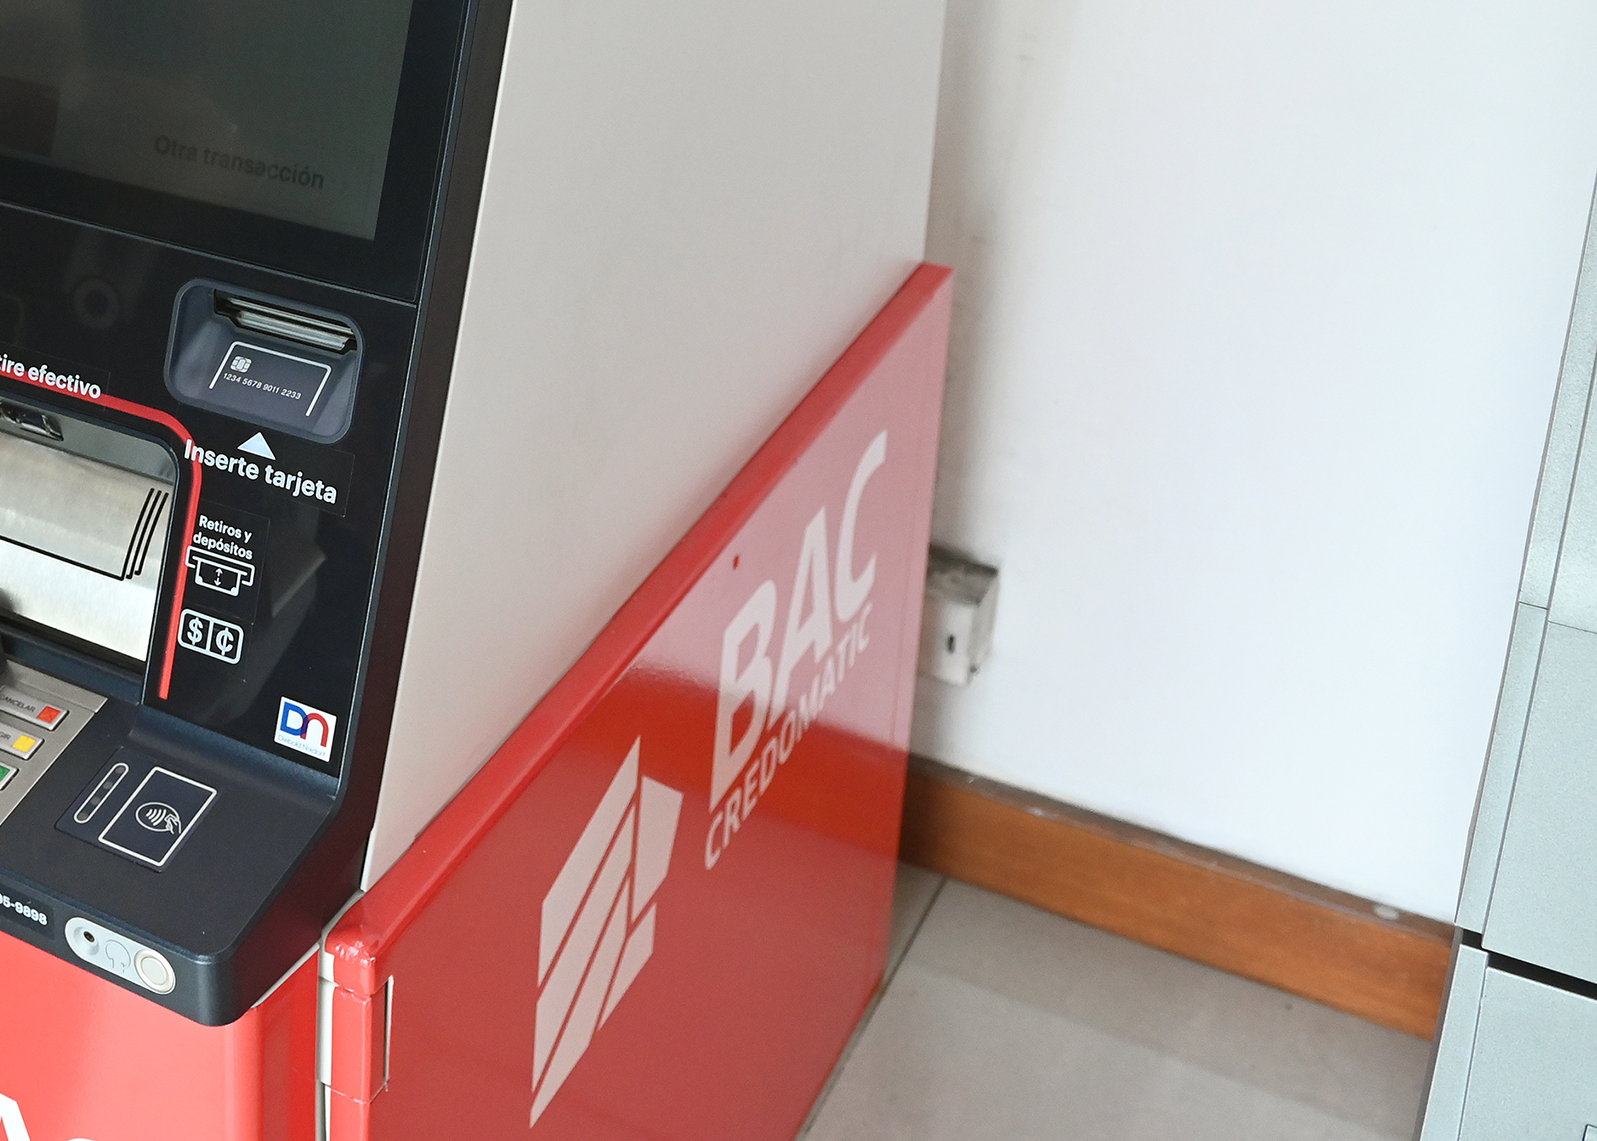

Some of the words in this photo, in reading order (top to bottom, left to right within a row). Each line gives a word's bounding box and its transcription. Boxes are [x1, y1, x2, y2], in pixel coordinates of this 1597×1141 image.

[154, 135, 199, 159] Otra
[203, 147, 325, 190] transacción
[27, 363, 102, 400] efectivo
[222, 372, 241, 384] 1234
[242, 377, 262, 390] 5678
[262, 382, 280, 395] 9011
[281, 388, 302, 401] 2233
[183, 438, 260, 481] Inserte
[264, 464, 338, 505] tarjeta
[192, 532, 253, 560] depósitos
[199, 514, 242, 539] Retiros
[243, 530, 253, 544] y
[709, 430, 888, 813] BAC
[0, 694, 36, 713] CANCELAR
[705, 602, 873, 871] CREDOMATIC
